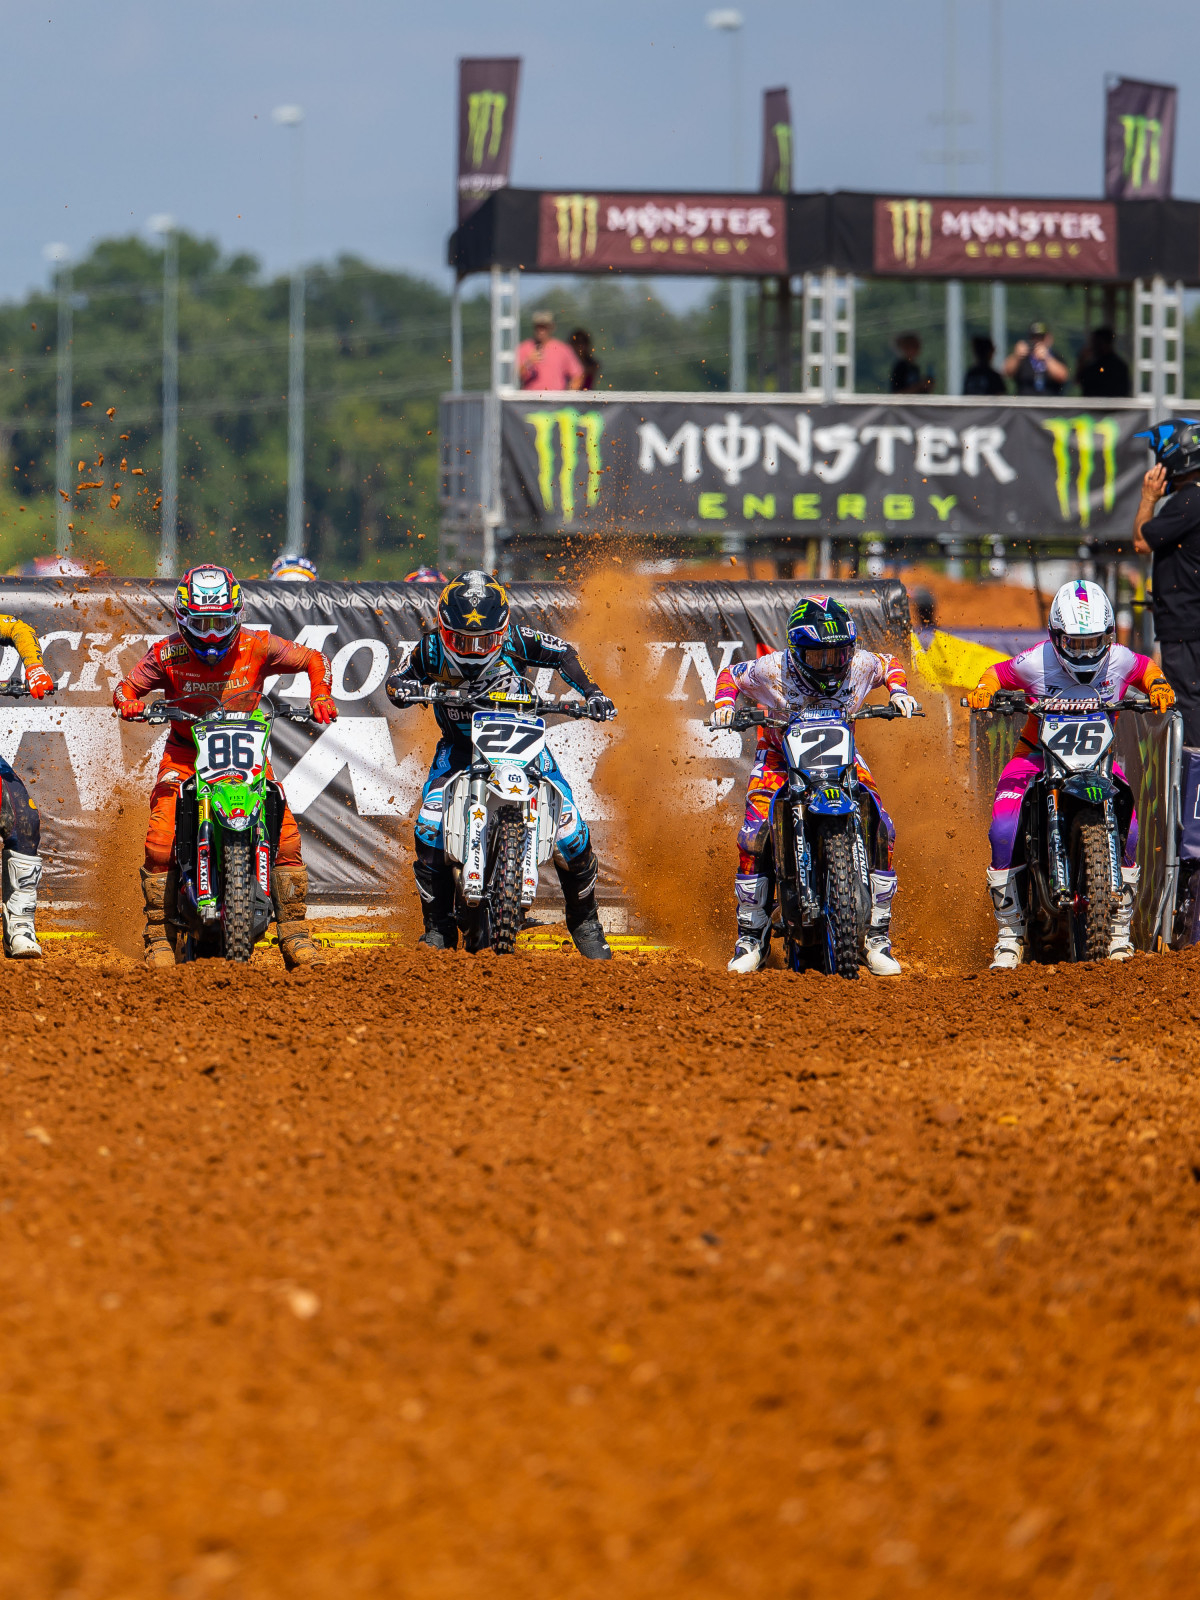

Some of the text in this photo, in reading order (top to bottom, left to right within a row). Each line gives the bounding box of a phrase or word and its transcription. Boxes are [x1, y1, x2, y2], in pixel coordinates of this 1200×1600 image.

[607, 202, 776, 238] MONSTER
[941, 206, 1106, 242] MONSTER
[637, 412, 1016, 485] MONSTER
[699, 492, 958, 520] ENERGY
[160, 645, 189, 662] BLASTER
[193, 677, 249, 692] PARTZILLA
[208, 732, 254, 770] 86
[475, 723, 544, 754] 27
[800, 728, 844, 770] 2
[1048, 722, 1106, 756] 46
[259, 850, 268, 892] MAXXIS
[856, 833, 869, 886] DUNLOP
[1107, 833, 1118, 891] DUNLOP
